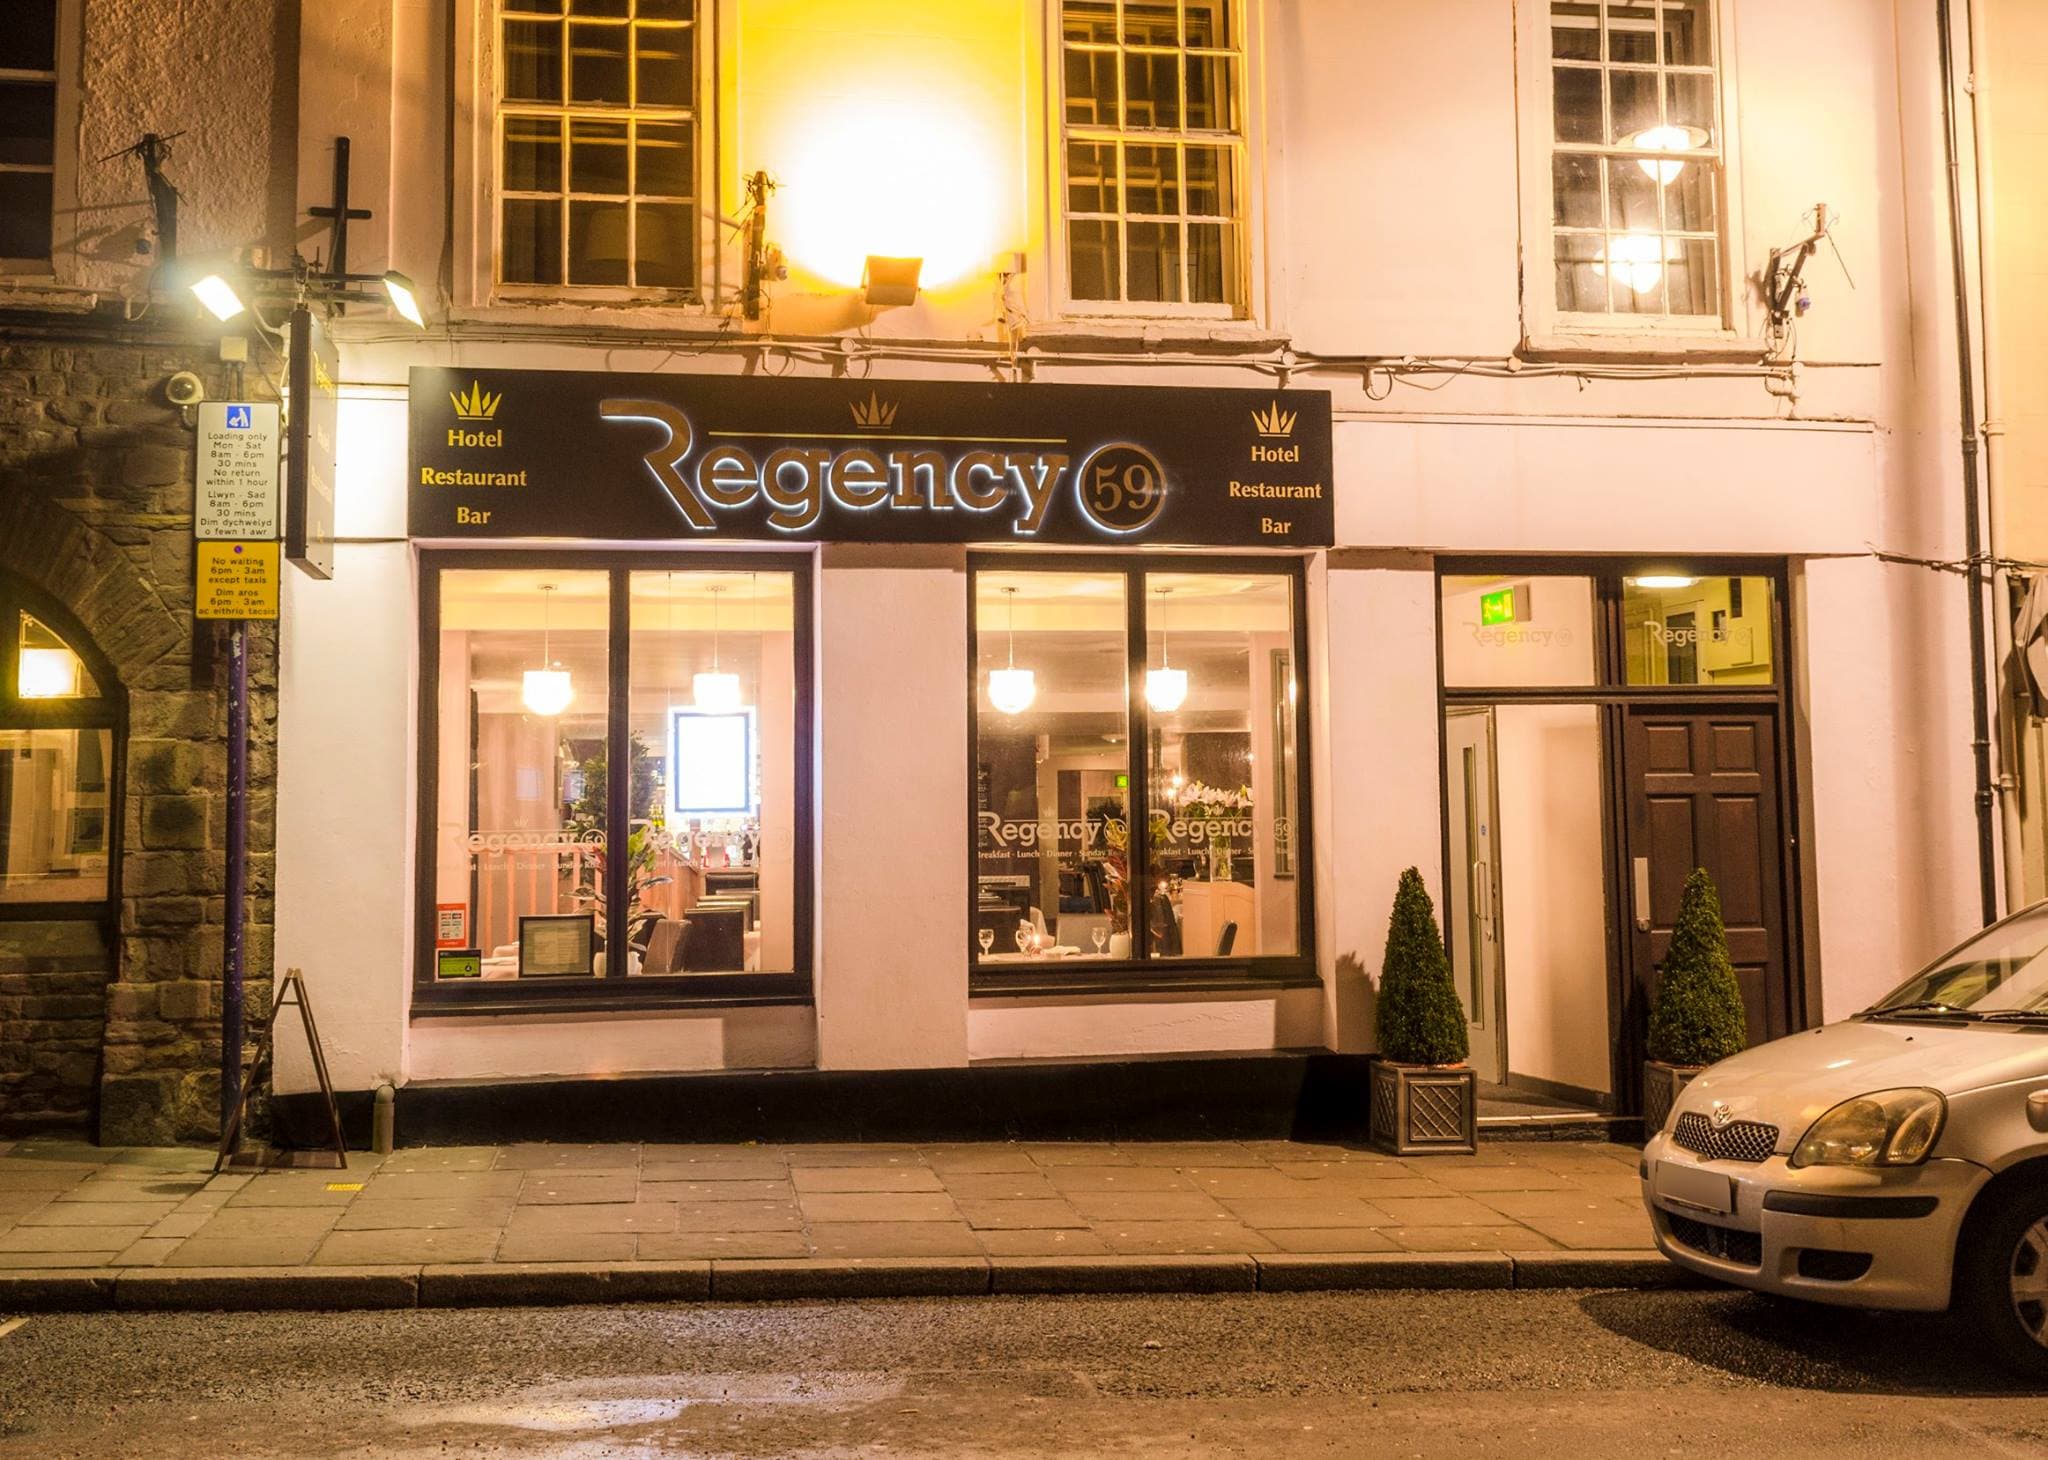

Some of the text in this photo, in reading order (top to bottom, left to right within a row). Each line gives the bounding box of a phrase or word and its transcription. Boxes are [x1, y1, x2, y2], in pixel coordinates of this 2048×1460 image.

[208, 432, 267, 441] Loading only
[447, 429, 502, 447] Hotel
[213, 441, 233, 449] Mon
[243, 450, 264, 459] 6pm
[1251, 445, 1299, 462] Hotel
[217, 459, 231, 467] 30
[599, 398, 1153, 534] Regency 59
[421, 467, 527, 487] Restaurant
[1229, 481, 1322, 498] Restaurant
[242, 500, 263, 508] 6pm
[217, 509, 230, 517] 30
[457, 507, 491, 524] Bar
[200, 518, 272, 527] Dim dychwelyd
[1262, 517, 1291, 534] Bar
[212, 557, 264, 566] No waiting
[216, 588, 234, 596] Dim
[1462, 621, 1554, 648] Regency
[978, 811, 1102, 847] Regency
[1149, 809, 1266, 843] Regenc
[1016, 850, 1040, 858] Lunch
